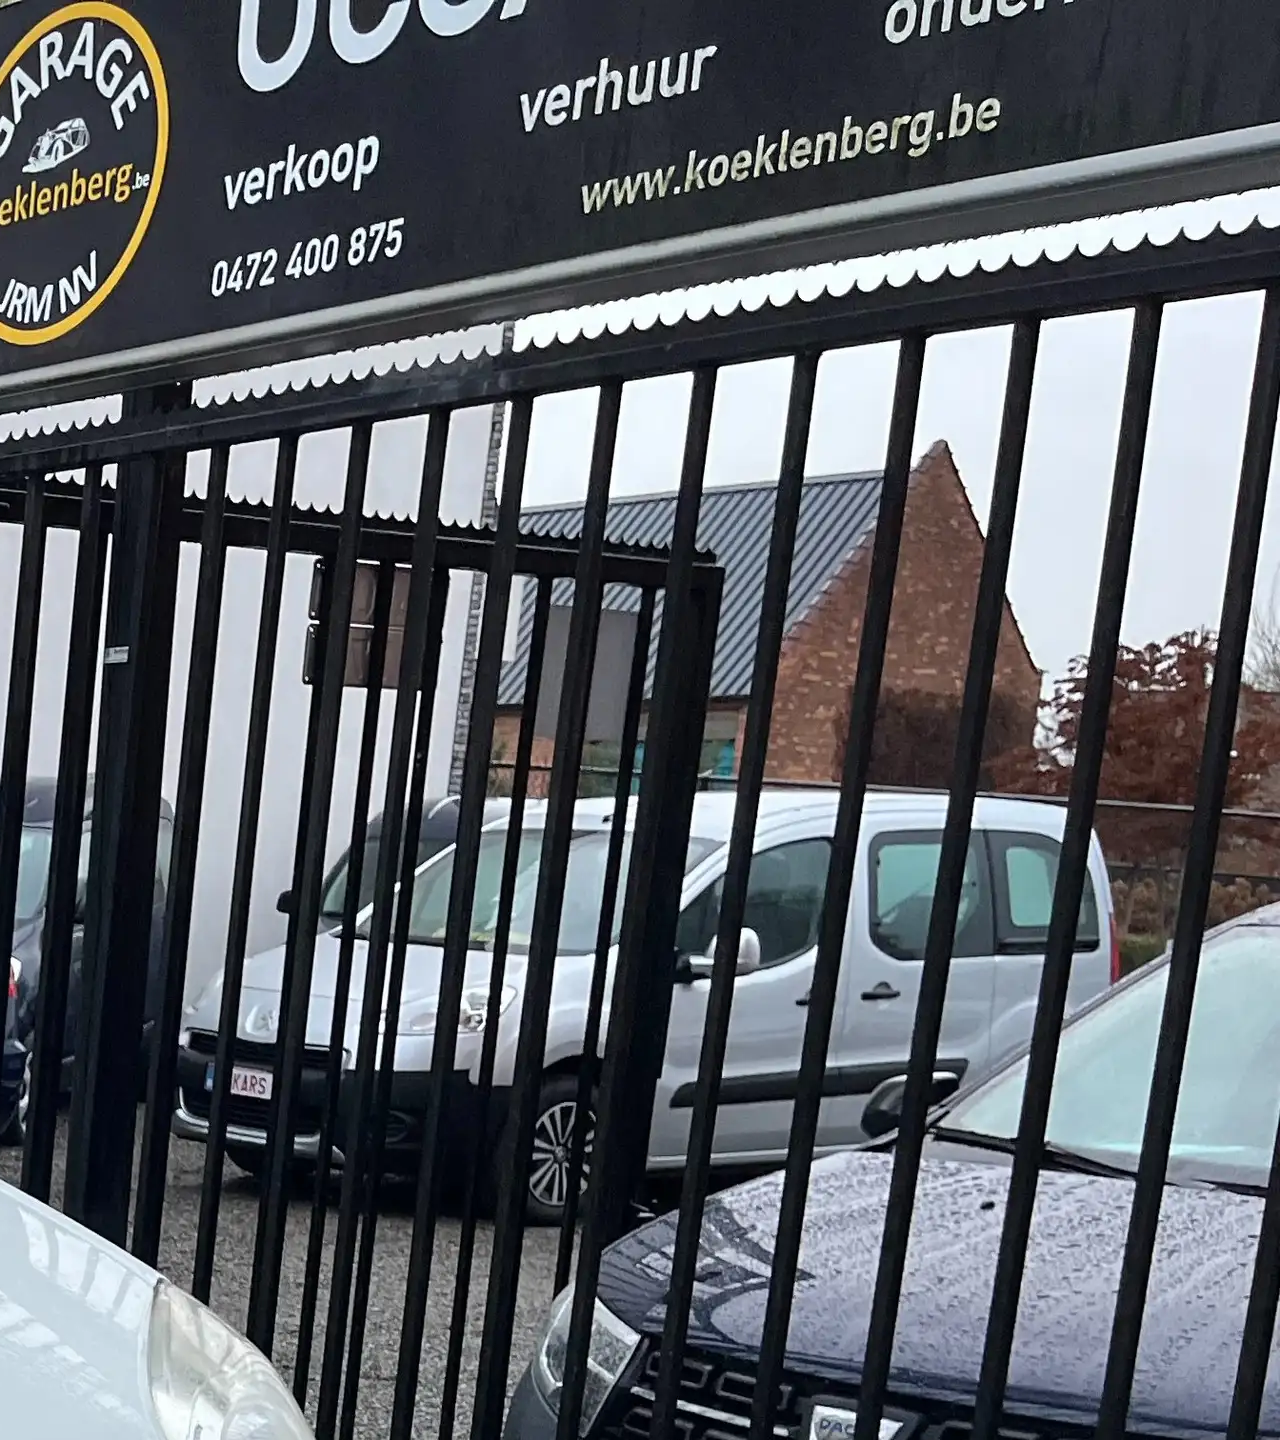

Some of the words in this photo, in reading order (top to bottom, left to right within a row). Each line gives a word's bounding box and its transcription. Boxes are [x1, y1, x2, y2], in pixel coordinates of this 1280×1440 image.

[520, 45, 718, 133] verhuur
[224, 135, 380, 210] verkoop
[581, 93, 1002, 214] www.koeklenberg.be
[59, 250, 97, 314] NV
[211, 248, 278, 297] 0472
[285, 233, 339, 279] 400
[347, 217, 405, 267] 875
[231, 1073, 268, 1095] KARS
